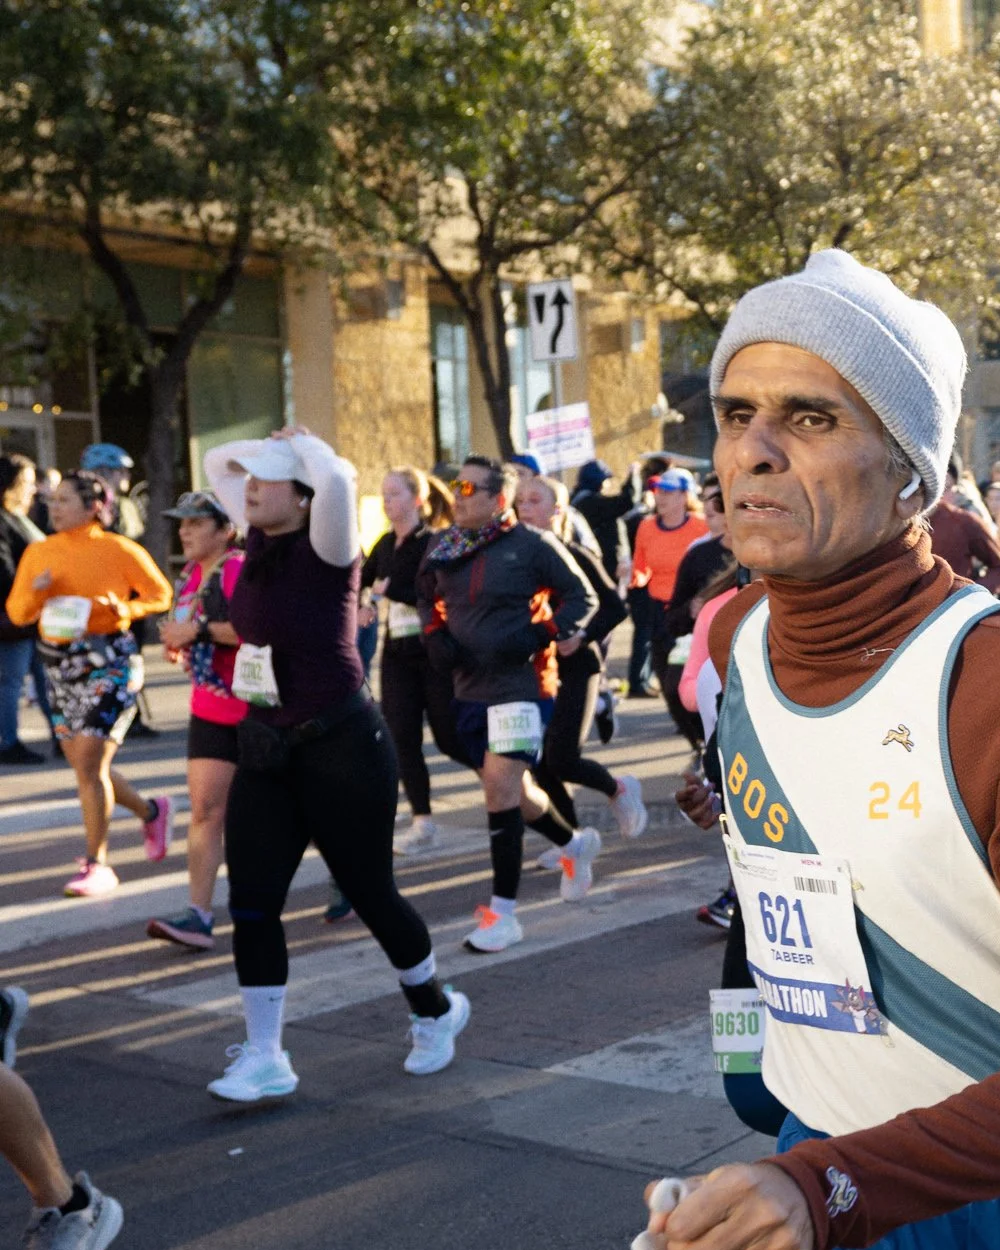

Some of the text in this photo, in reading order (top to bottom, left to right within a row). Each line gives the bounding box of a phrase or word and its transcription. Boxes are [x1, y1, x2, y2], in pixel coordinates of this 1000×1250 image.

[727, 752, 789, 843] BOS
[867, 780, 922, 820] 24
[758, 890, 813, 949] 621
[771, 948, 815, 965] TABEER
